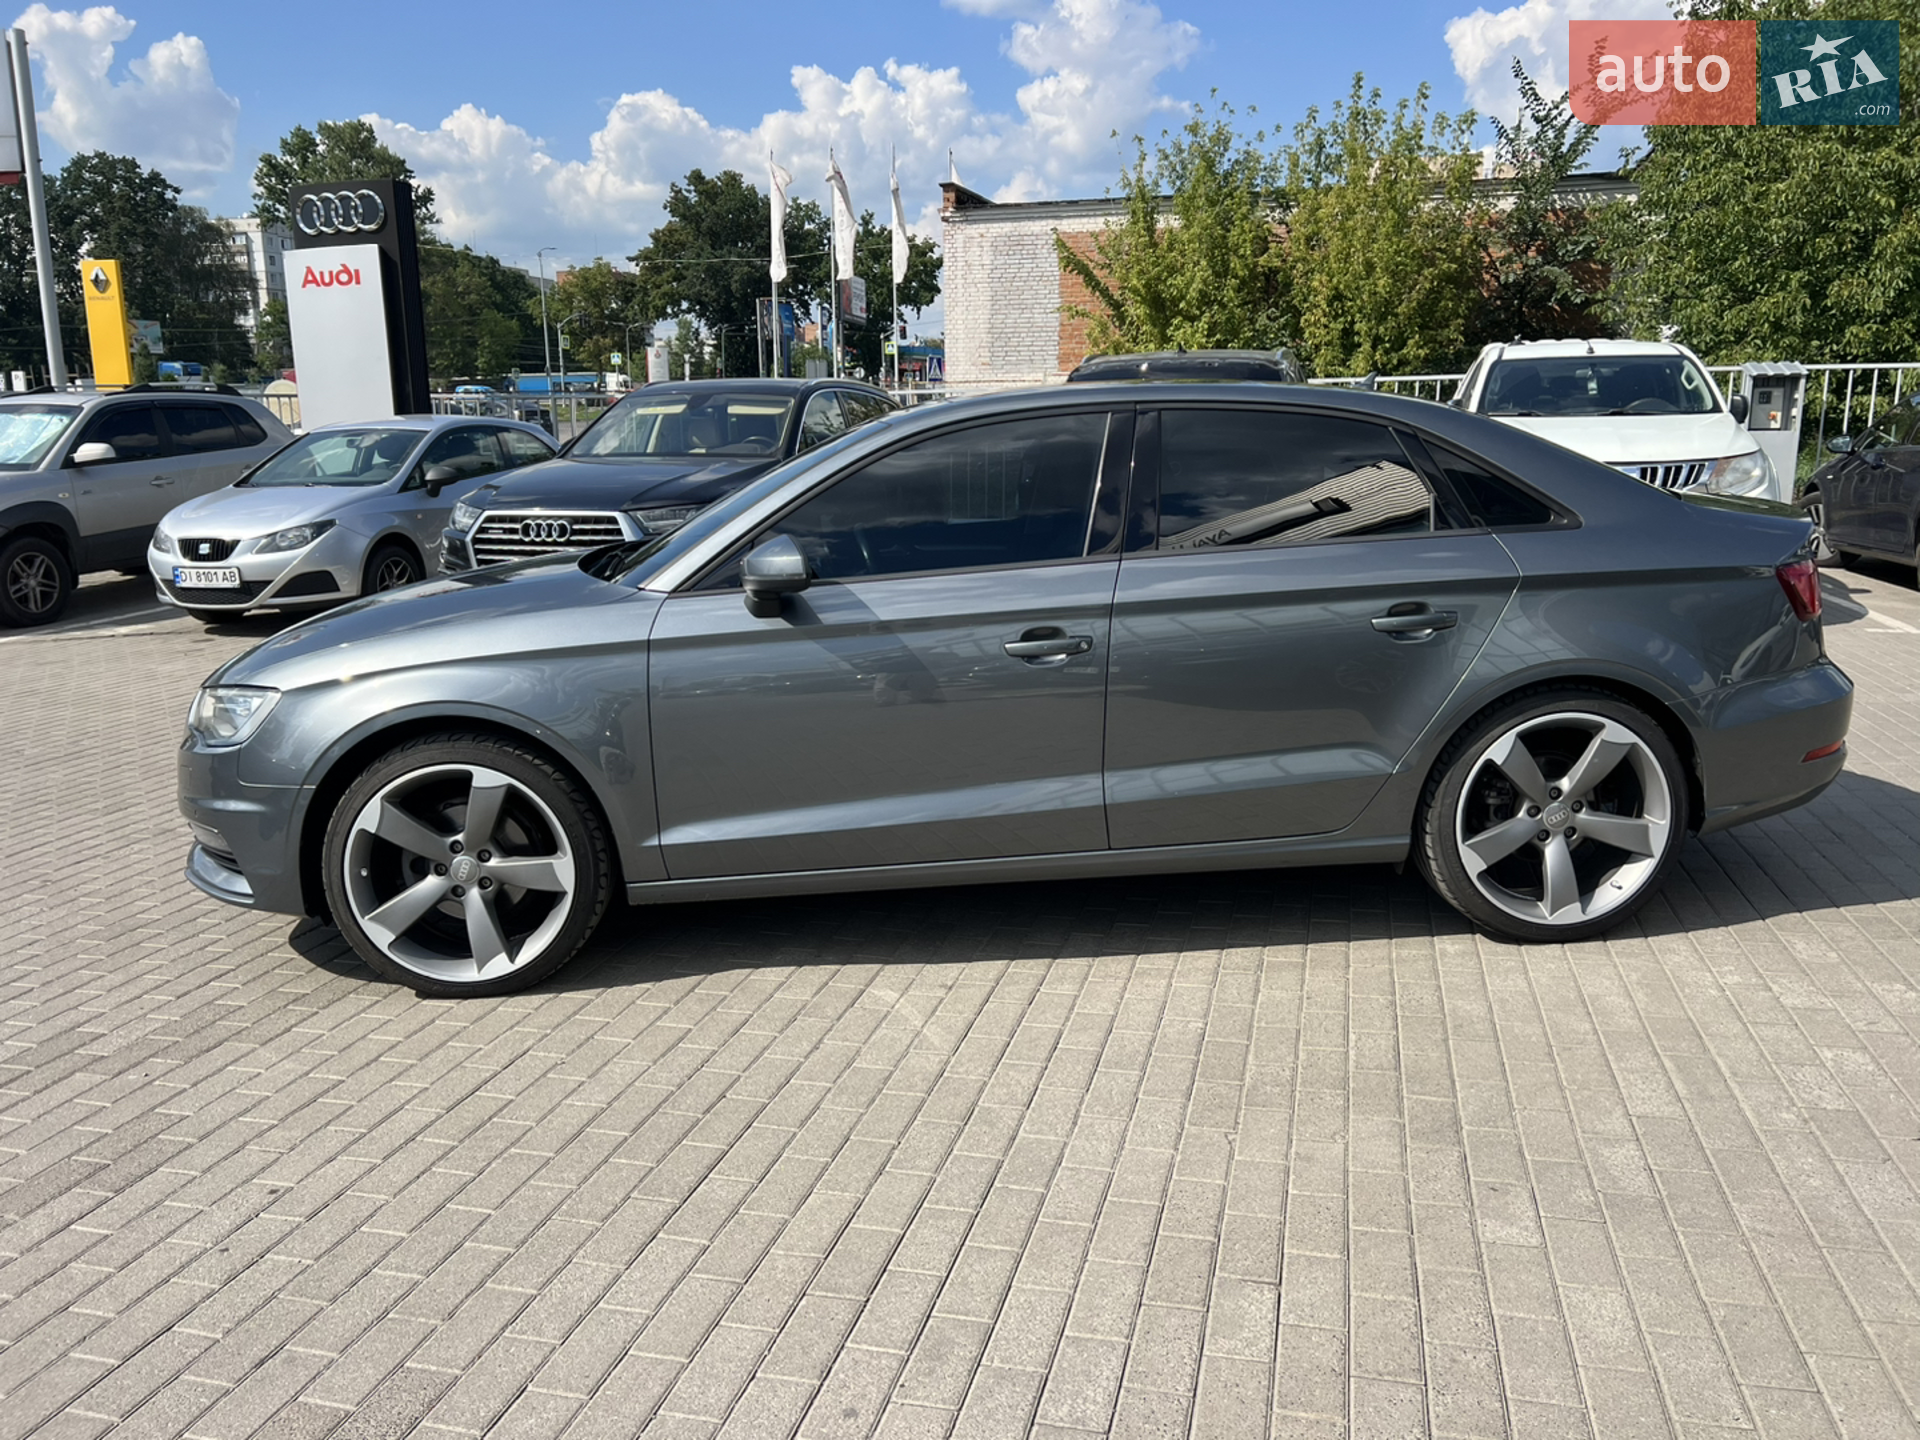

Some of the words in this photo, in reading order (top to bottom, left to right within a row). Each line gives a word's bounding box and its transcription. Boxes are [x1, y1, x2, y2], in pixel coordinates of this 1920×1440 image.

[301, 263, 361, 289] Audi
[180, 571, 193, 583] DI
[196, 571, 219, 583] 8101
[222, 571, 237, 583] AB
